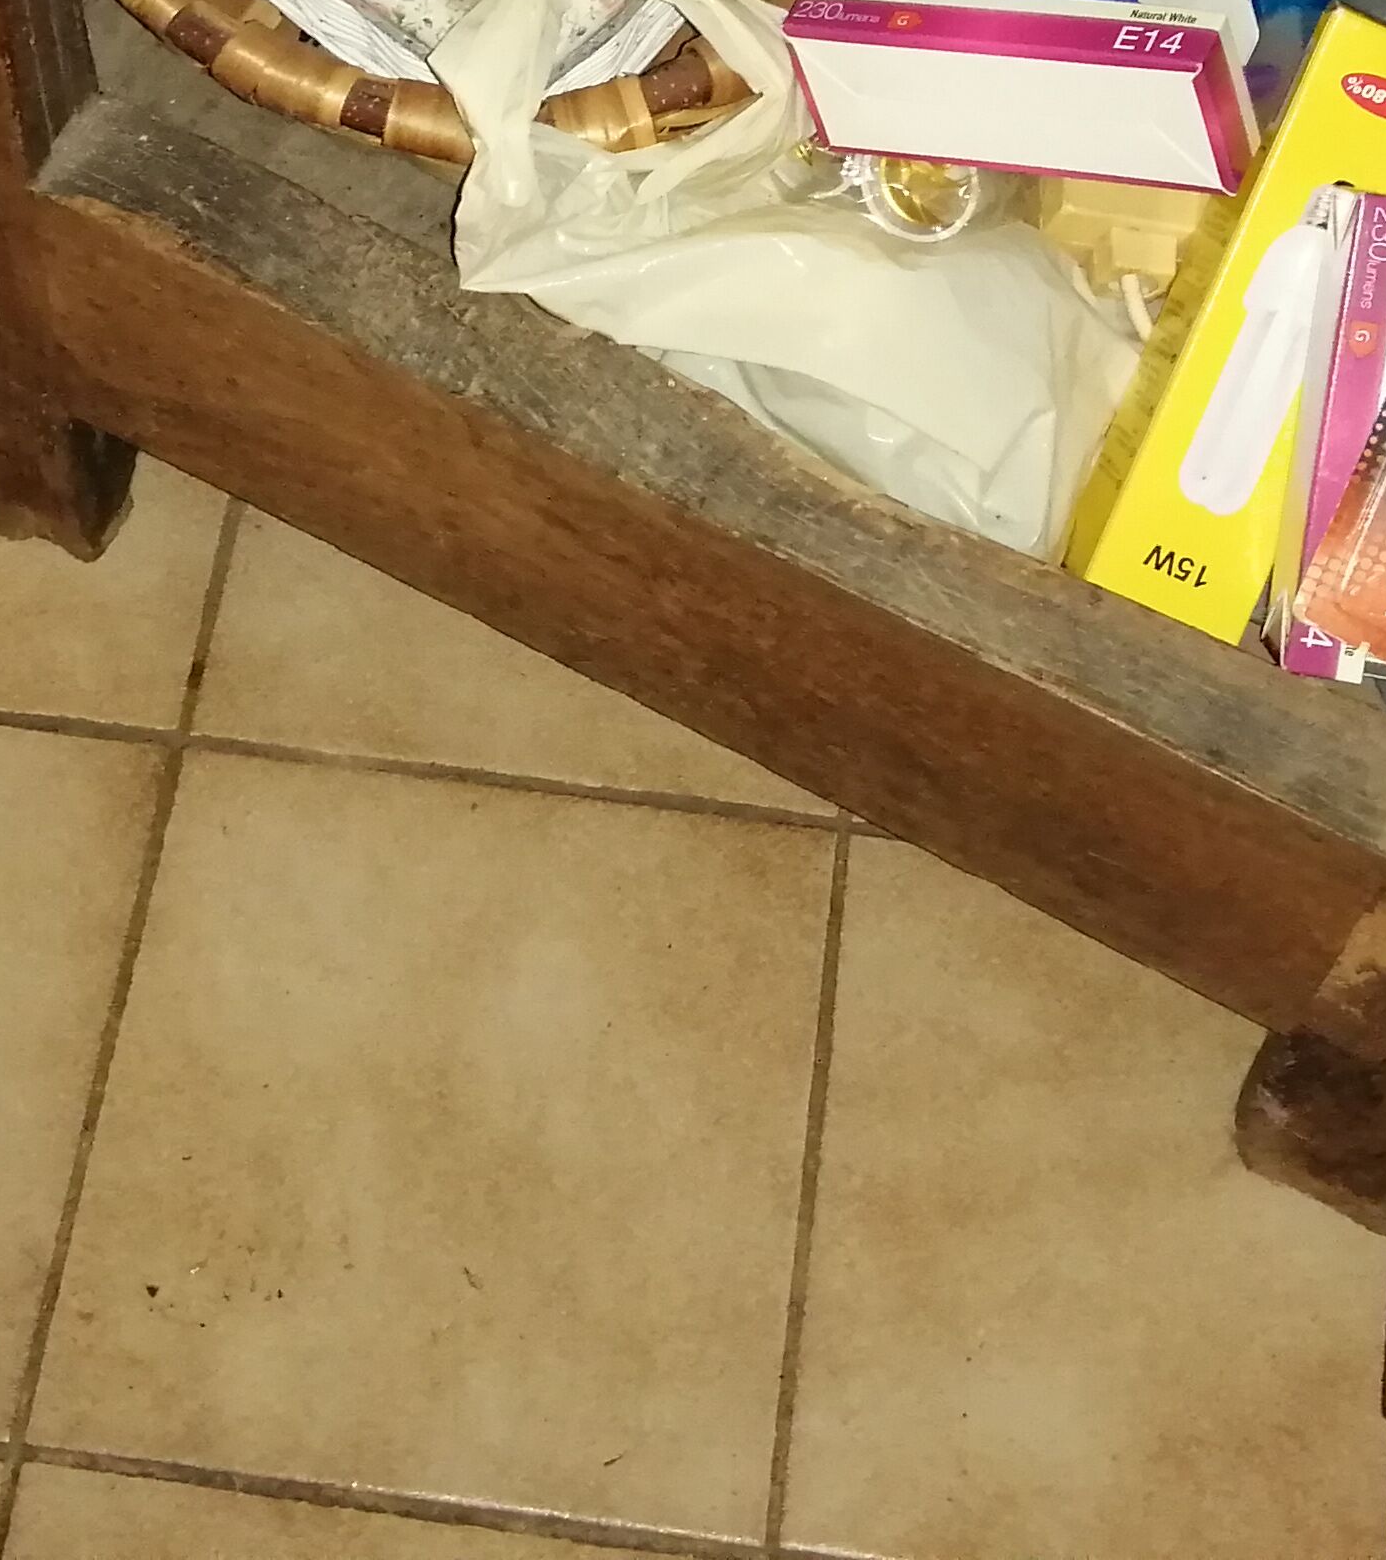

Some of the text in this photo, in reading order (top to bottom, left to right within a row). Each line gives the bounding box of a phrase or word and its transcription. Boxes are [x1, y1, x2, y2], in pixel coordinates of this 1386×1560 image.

[1129, 8, 1198, 25] Natural White
[1112, 25, 1183, 55] E14
[1143, 544, 1208, 589] 15W
